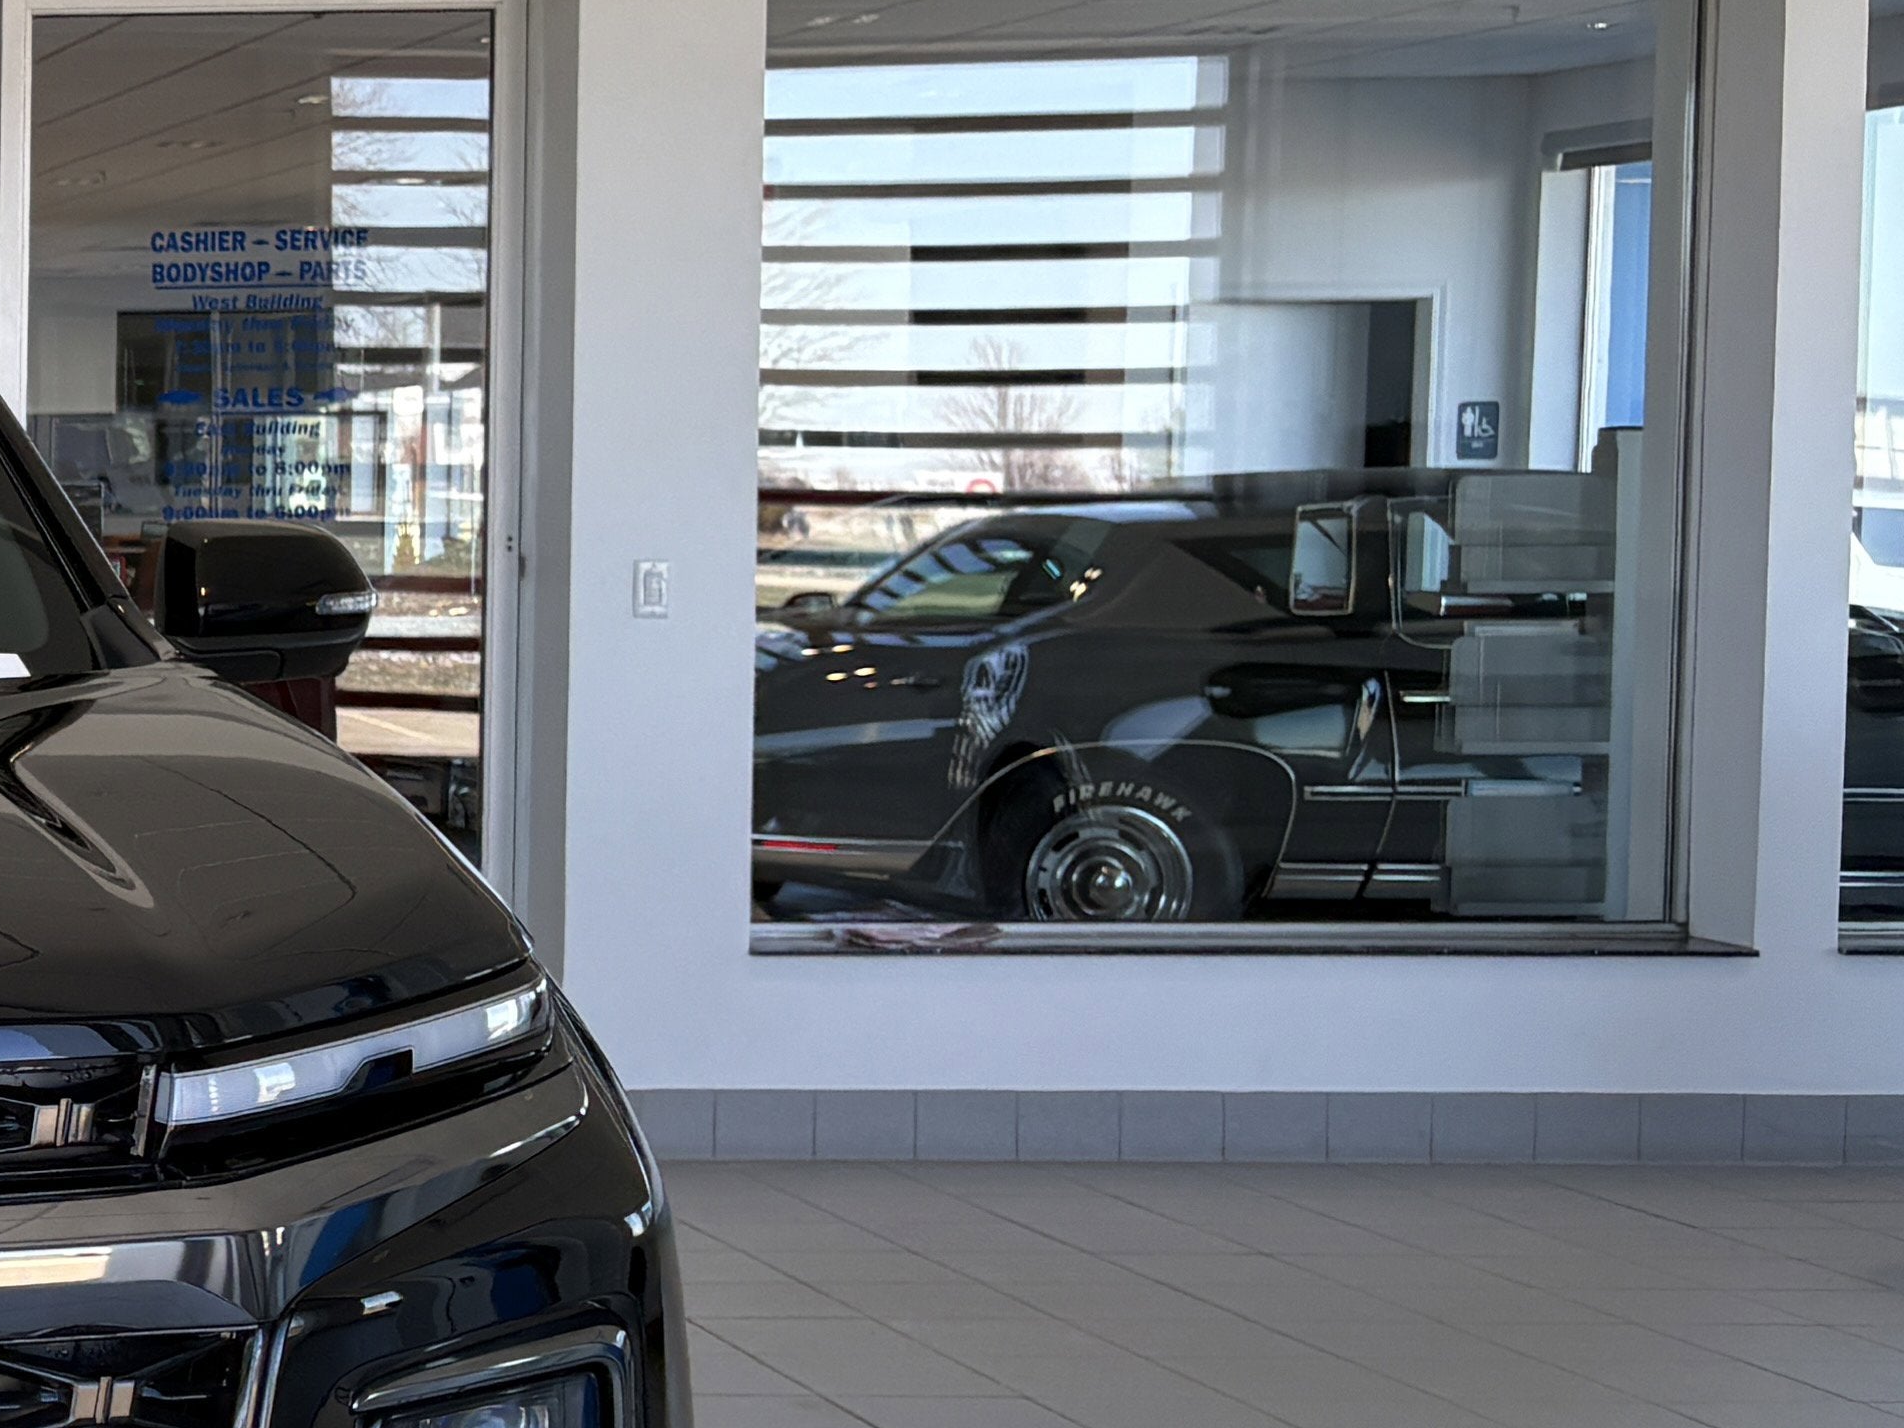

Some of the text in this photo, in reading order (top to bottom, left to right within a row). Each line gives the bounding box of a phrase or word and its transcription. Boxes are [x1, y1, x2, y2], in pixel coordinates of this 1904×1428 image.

[150, 227, 369, 253] CASHIER SERVICE
[151, 259, 367, 284] BODYSHOP PARTS
[192, 292, 324, 311] West Building
[213, 386, 306, 408] SALES
[1052, 780, 1193, 823] FIREHAWK
